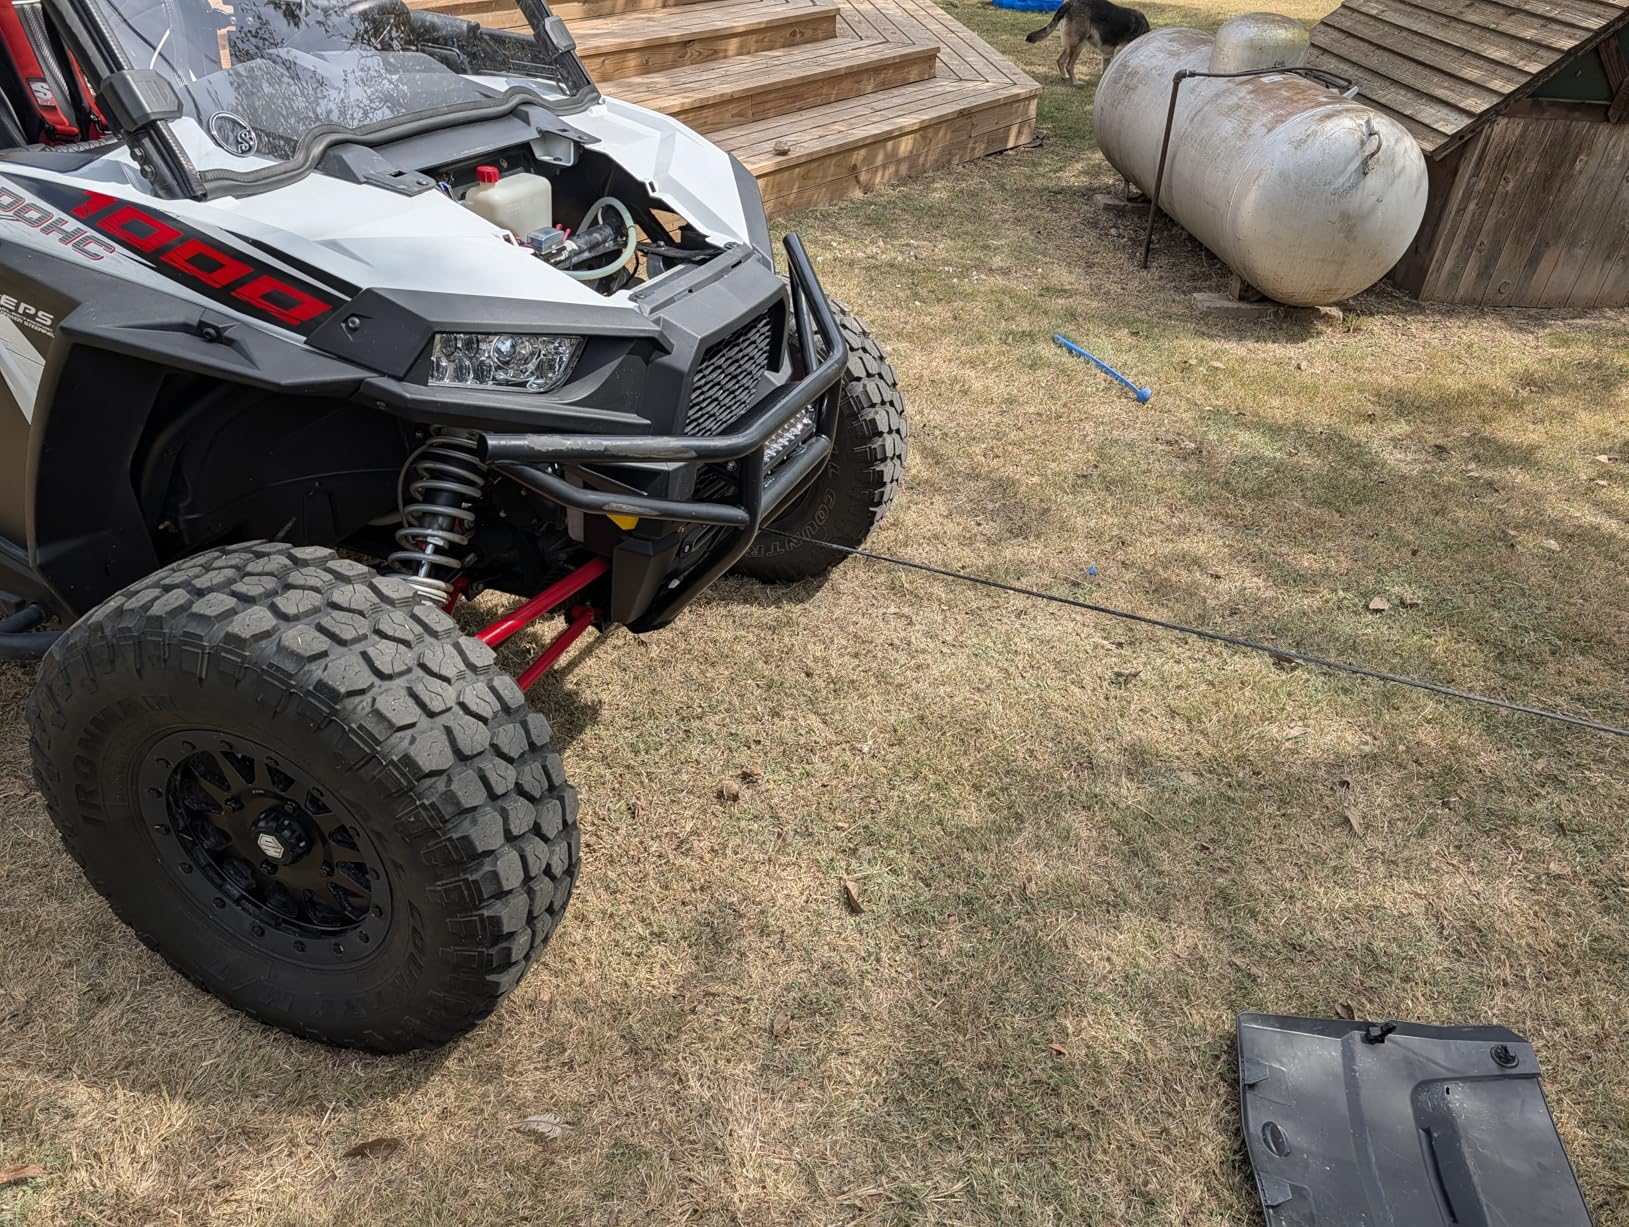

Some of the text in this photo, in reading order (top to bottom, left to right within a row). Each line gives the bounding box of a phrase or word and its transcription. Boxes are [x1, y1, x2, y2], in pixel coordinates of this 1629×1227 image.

[69, 189, 333, 326] 1000
[0, 294, 54, 326] EPS
[746, 487, 837, 558] COUNTR
